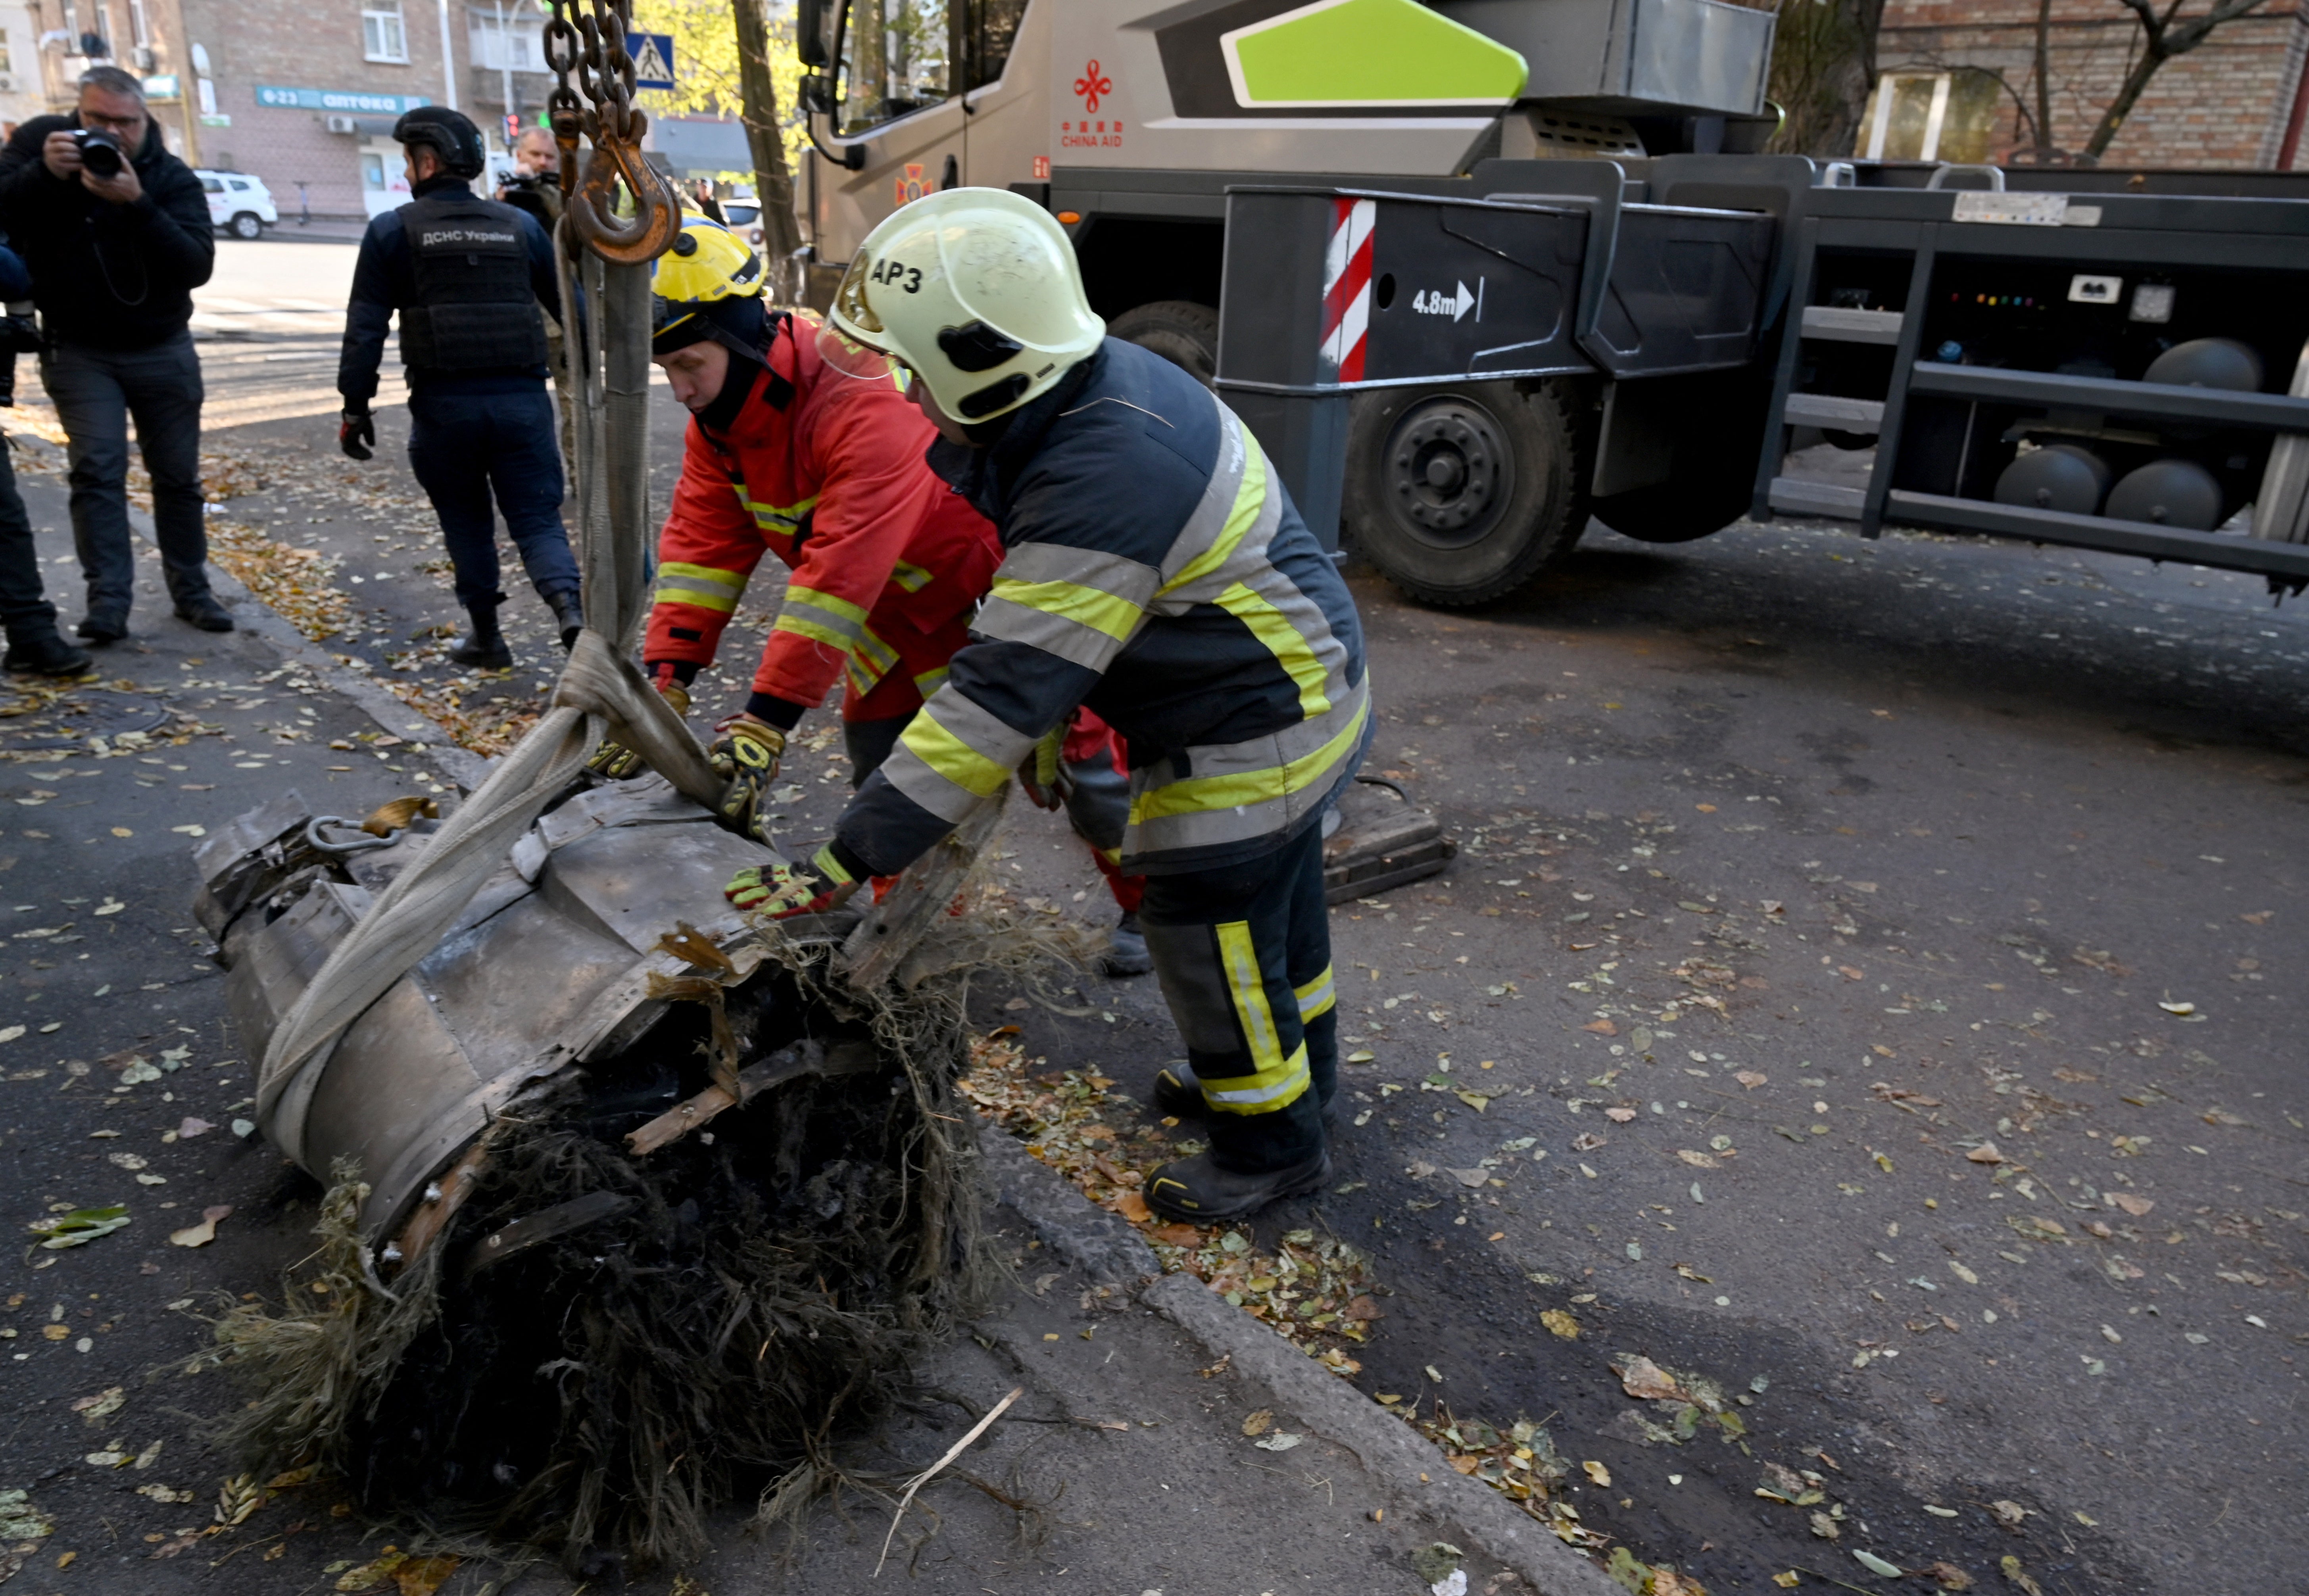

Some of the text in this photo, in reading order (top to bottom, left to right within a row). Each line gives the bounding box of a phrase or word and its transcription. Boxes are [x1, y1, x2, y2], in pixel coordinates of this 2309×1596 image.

[322, 94, 396, 111] аптека
[1062, 136, 1122, 147] CHINA AID
[423, 230, 515, 246] ДСНС України
[1412, 289, 1456, 315] 4.8m
